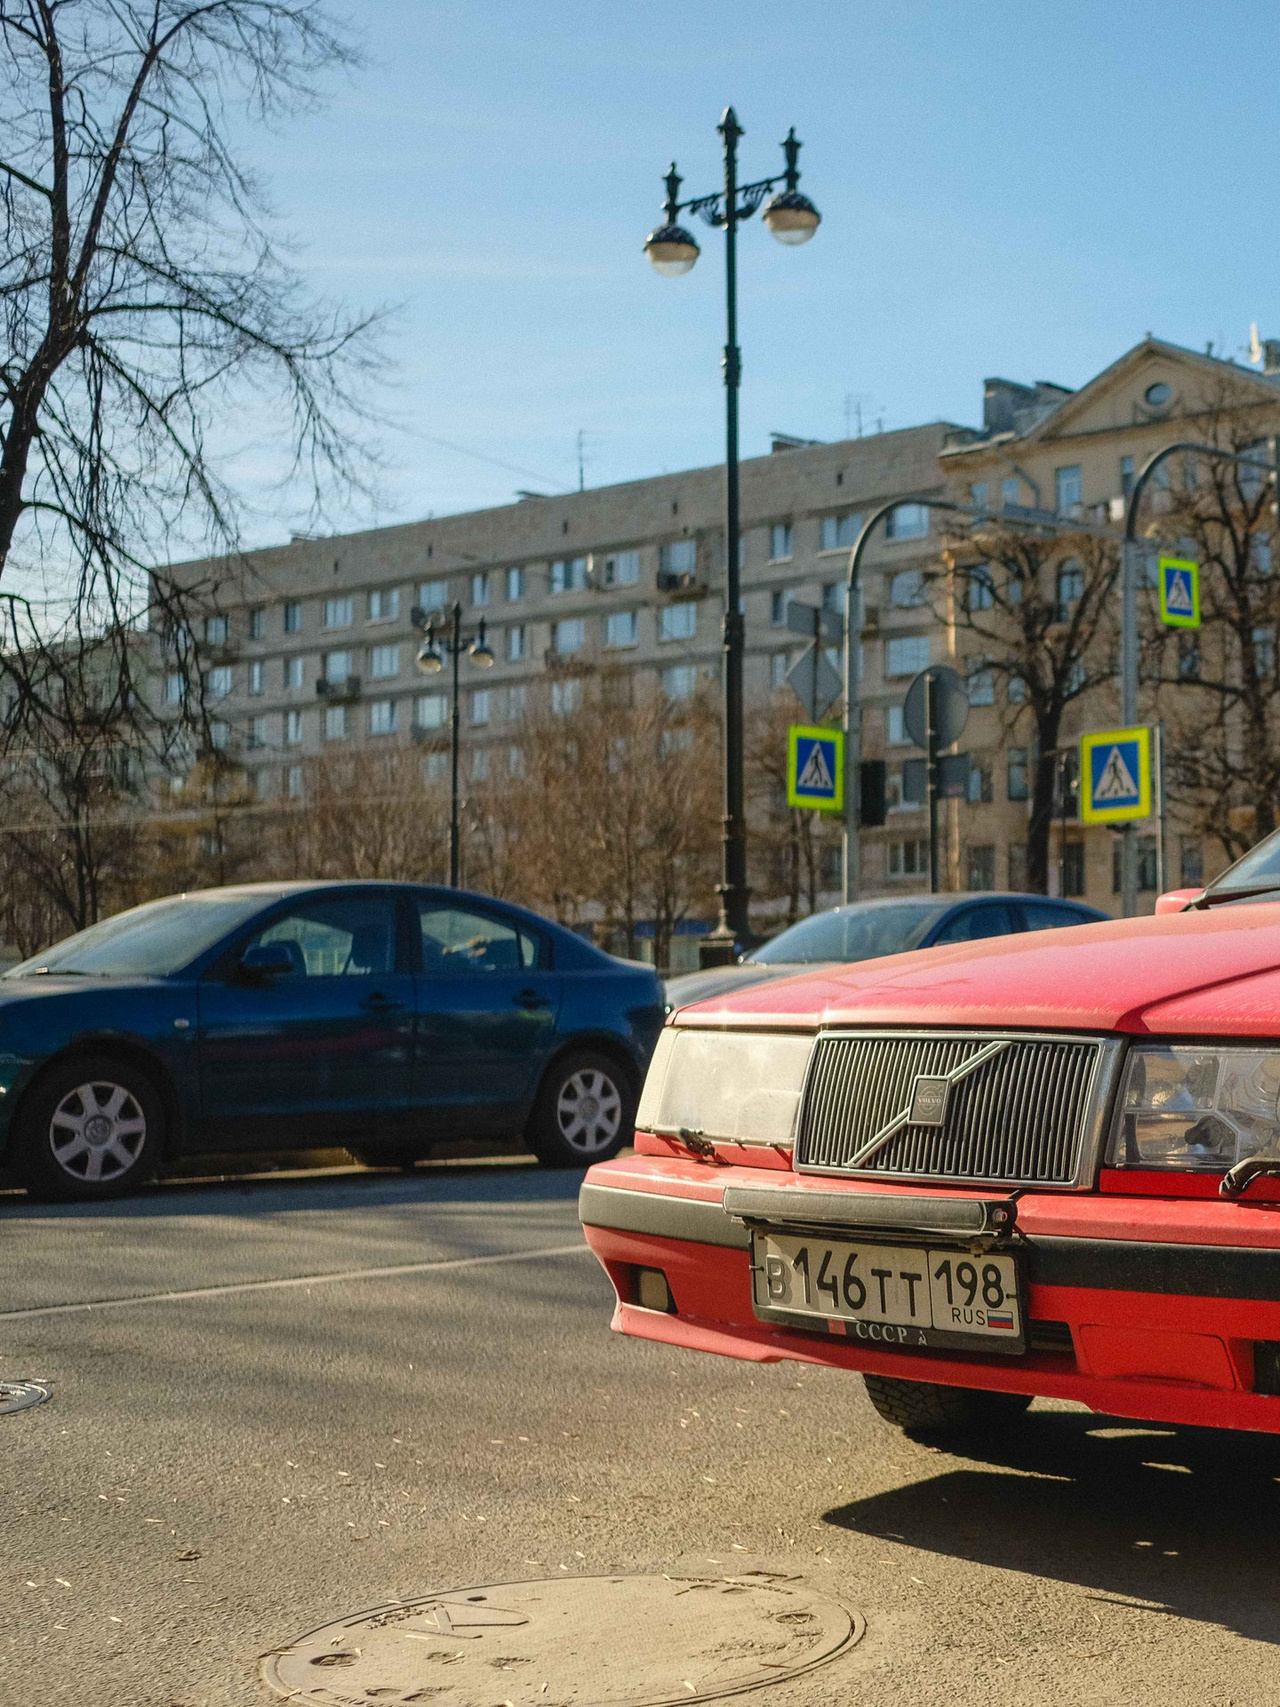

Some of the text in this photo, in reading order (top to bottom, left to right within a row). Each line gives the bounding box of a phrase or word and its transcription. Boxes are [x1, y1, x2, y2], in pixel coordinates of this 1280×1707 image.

[934, 1259, 1004, 1309] 198
[951, 1307, 986, 1326] RUS
[855, 1321, 908, 1344] СССР
